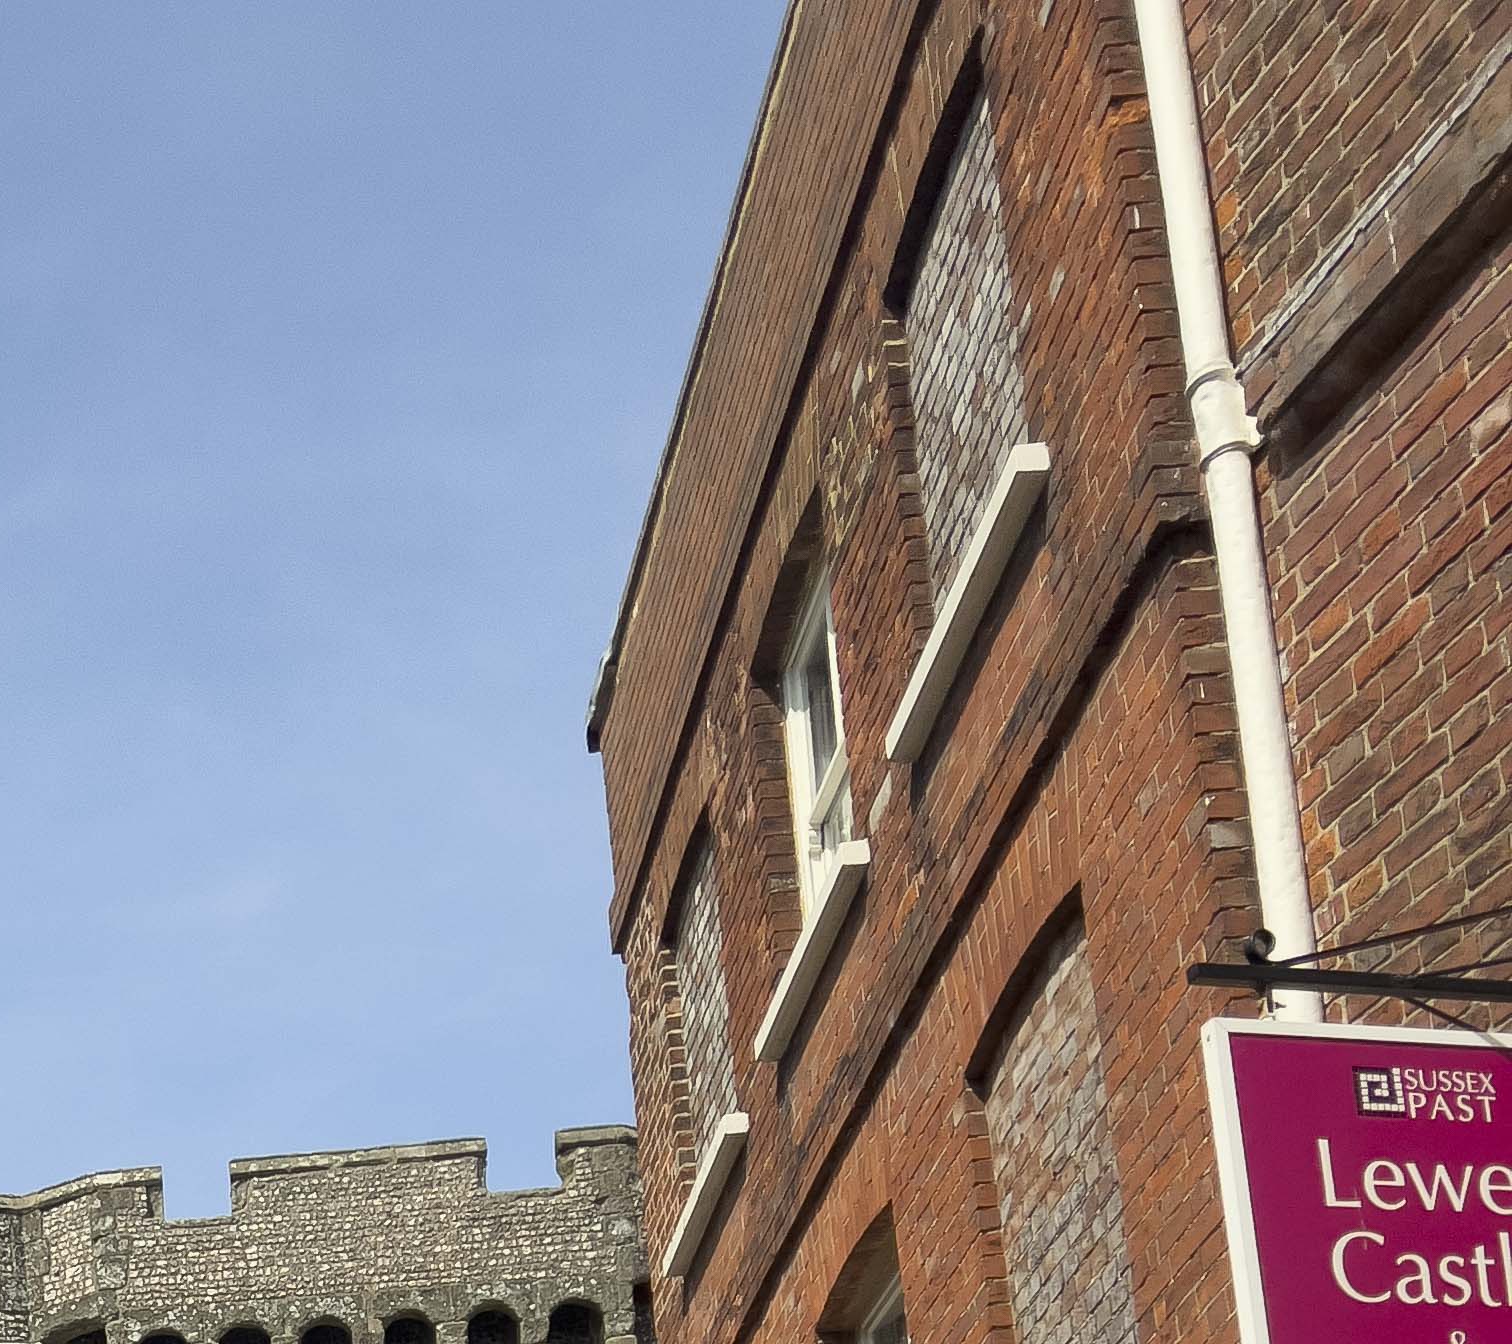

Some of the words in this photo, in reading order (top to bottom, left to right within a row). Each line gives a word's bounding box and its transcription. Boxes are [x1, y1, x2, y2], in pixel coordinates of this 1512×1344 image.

[1403, 1067, 1497, 1095] SUSSEX
[1407, 1092, 1497, 1123] PAST
[1331, 1229, 1512, 1309] Castl
